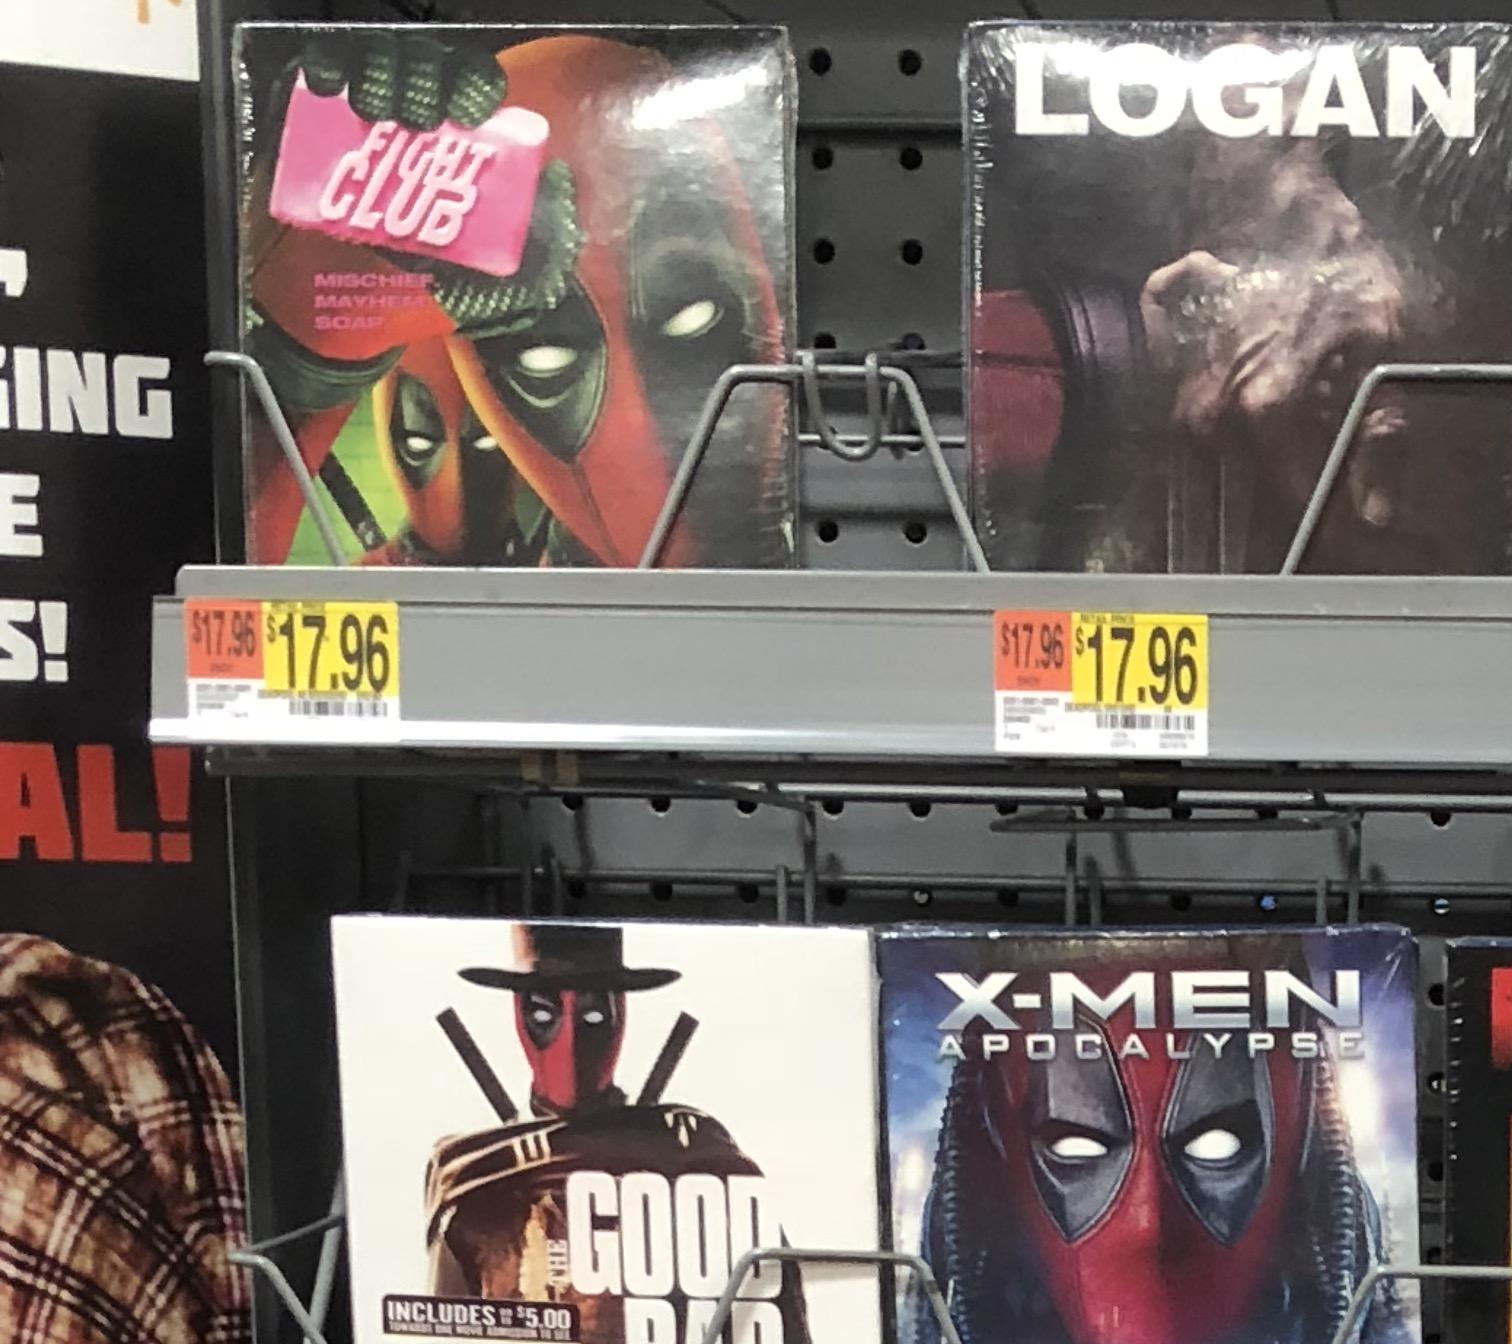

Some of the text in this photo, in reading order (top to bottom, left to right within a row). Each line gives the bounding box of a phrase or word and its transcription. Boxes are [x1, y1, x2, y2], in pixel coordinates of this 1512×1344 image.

[1014, 42, 1477, 138] LOGAN
[358, 120, 497, 189] FIGHT
[320, 150, 477, 246] CLUB
[0, 345, 173, 438] ING
[192, 610, 256, 657] $17.96
[266, 612, 390, 692] $17.96
[1001, 623, 1065, 669] $17.96
[1076, 625, 1198, 704] $17.96
[935, 969, 1363, 1030] X-MEN
[935, 1032, 1366, 1061] APOCALYPSE
[566, 1170, 782, 1299] GOOD
[387, 1300, 571, 1330] INCLUDES $5.00
